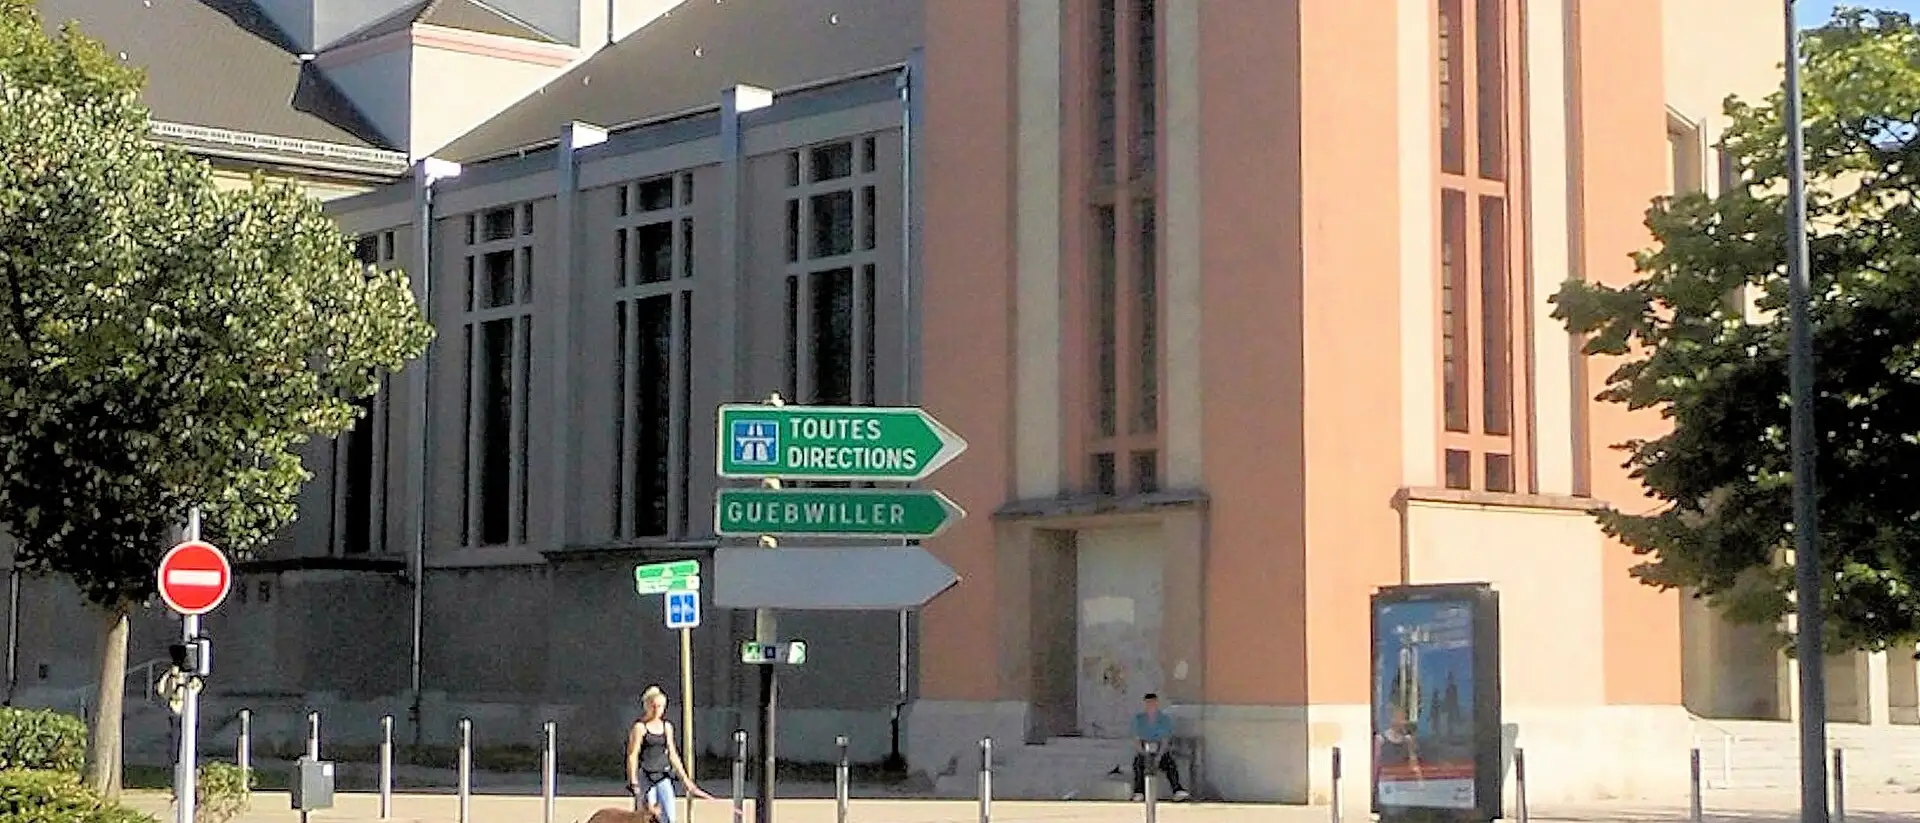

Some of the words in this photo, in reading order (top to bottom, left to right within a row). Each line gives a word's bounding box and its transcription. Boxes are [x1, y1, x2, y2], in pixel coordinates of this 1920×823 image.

[789, 417, 881, 440] TOUTES
[787, 446, 917, 470] DIRECTIONS
[727, 500, 905, 524] GUEBWILLER
